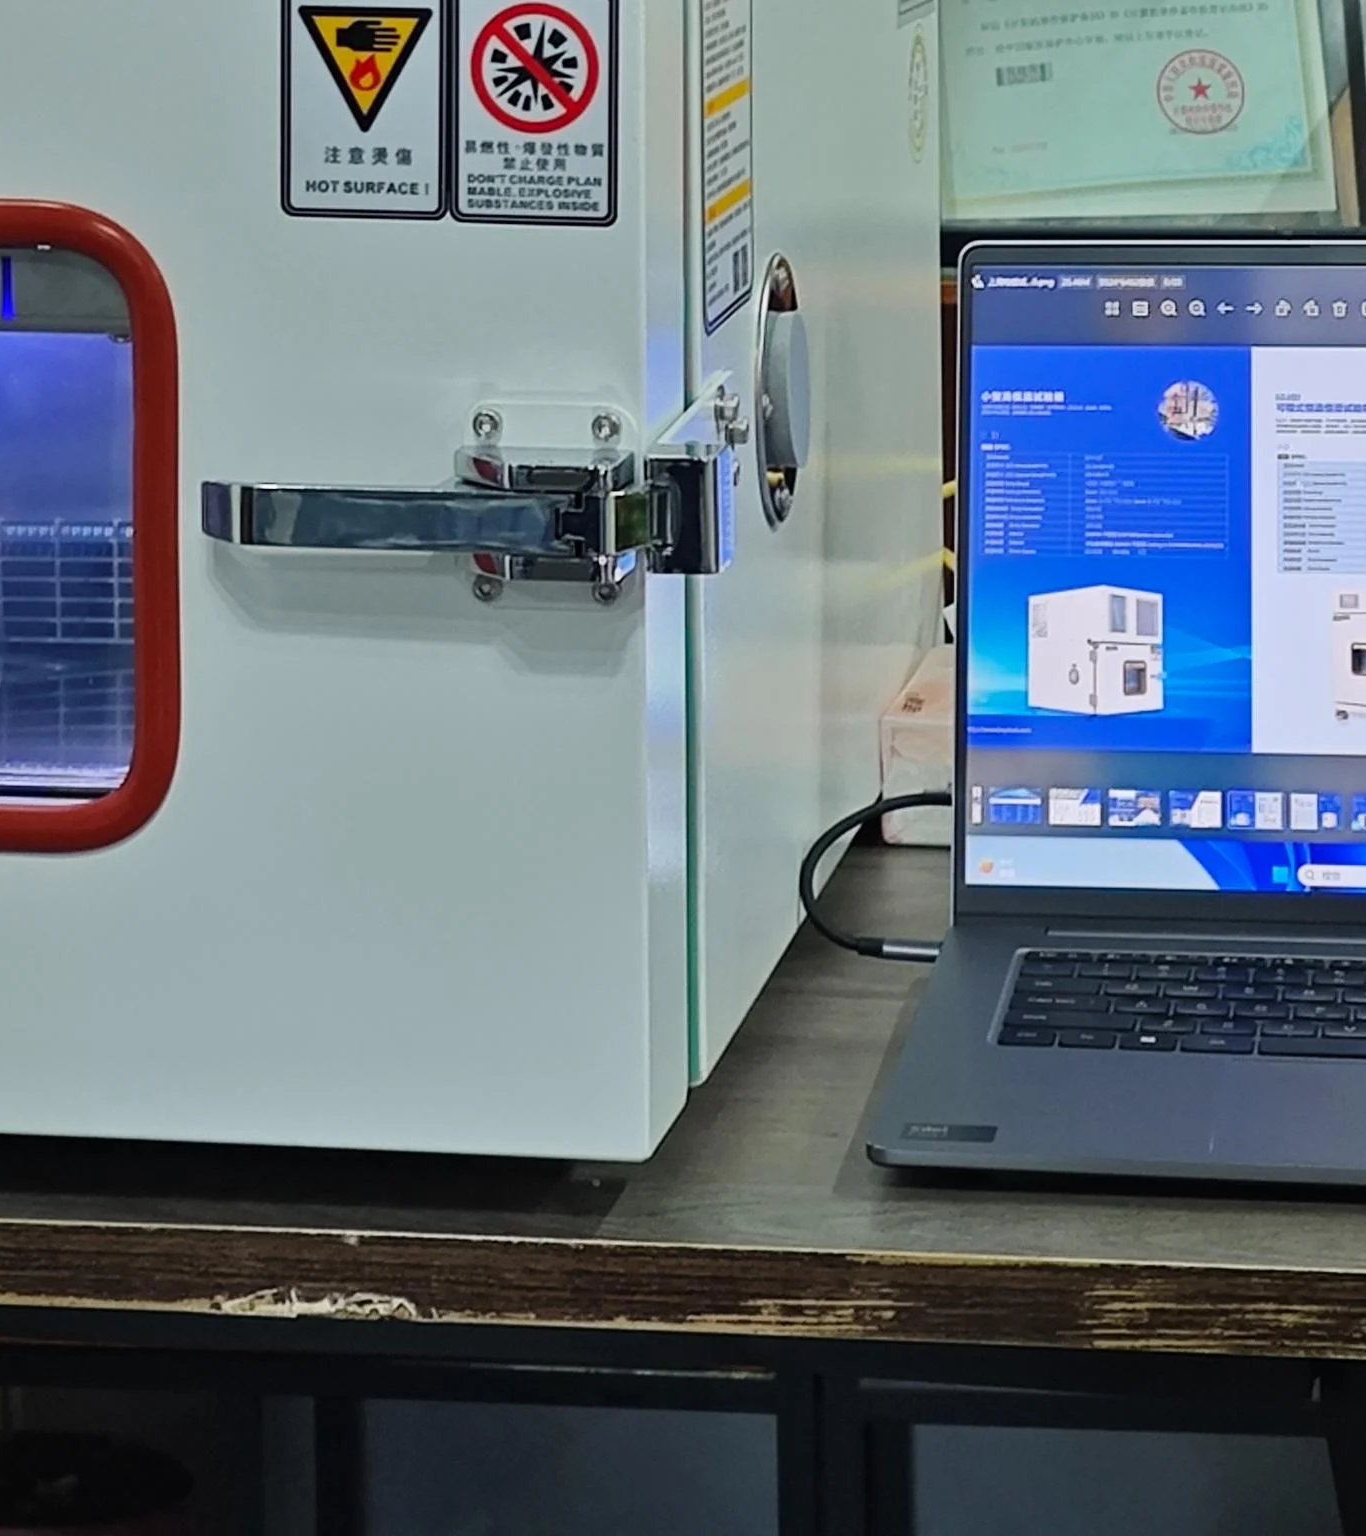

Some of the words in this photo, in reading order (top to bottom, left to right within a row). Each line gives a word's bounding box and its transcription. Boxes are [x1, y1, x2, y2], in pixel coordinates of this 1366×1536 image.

[502, 157, 567, 172] 禁止使用
[466, 173, 507, 185] DON'T
[509, 174, 564, 186] CHARGE
[305, 179, 340, 194] HOT
[343, 180, 420, 196] SURFACE
[518, 187, 593, 200] EXPLOSIVE
[466, 198, 554, 211] SUBSTANCES
[557, 200, 601, 213] INSIDE
